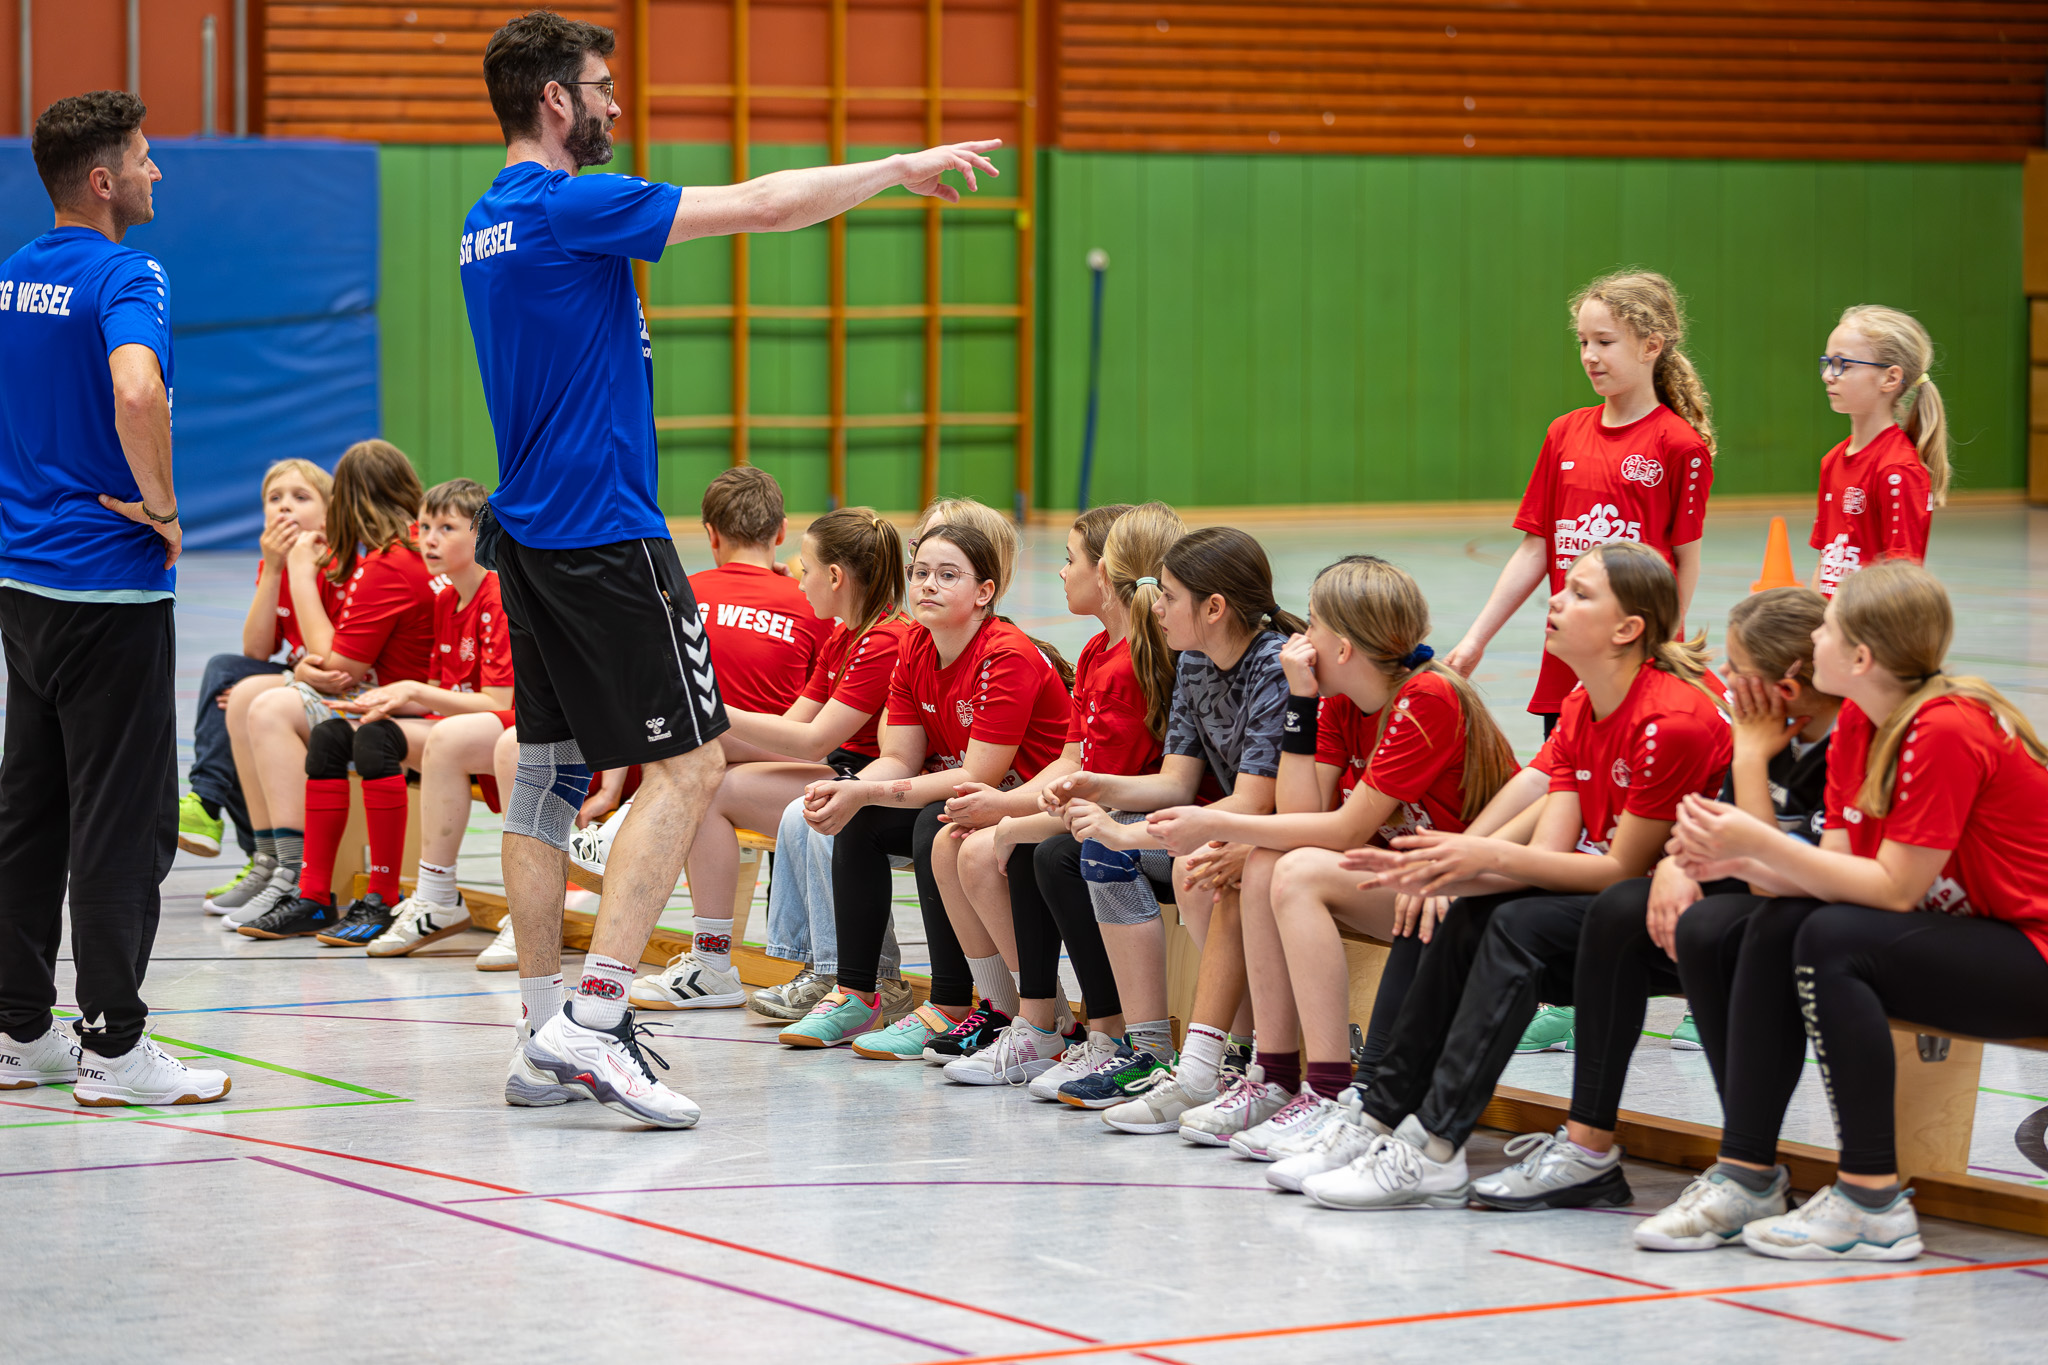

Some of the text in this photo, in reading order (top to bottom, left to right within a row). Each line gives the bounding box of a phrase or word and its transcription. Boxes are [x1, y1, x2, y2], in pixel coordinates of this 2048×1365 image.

[474, 220, 517, 261] WESEL
[0, 280, 74, 317] G WESEL
[716, 603, 795, 643] WESEL
[699, 936, 730, 949] HSG
[581, 978, 617, 995] HSG
